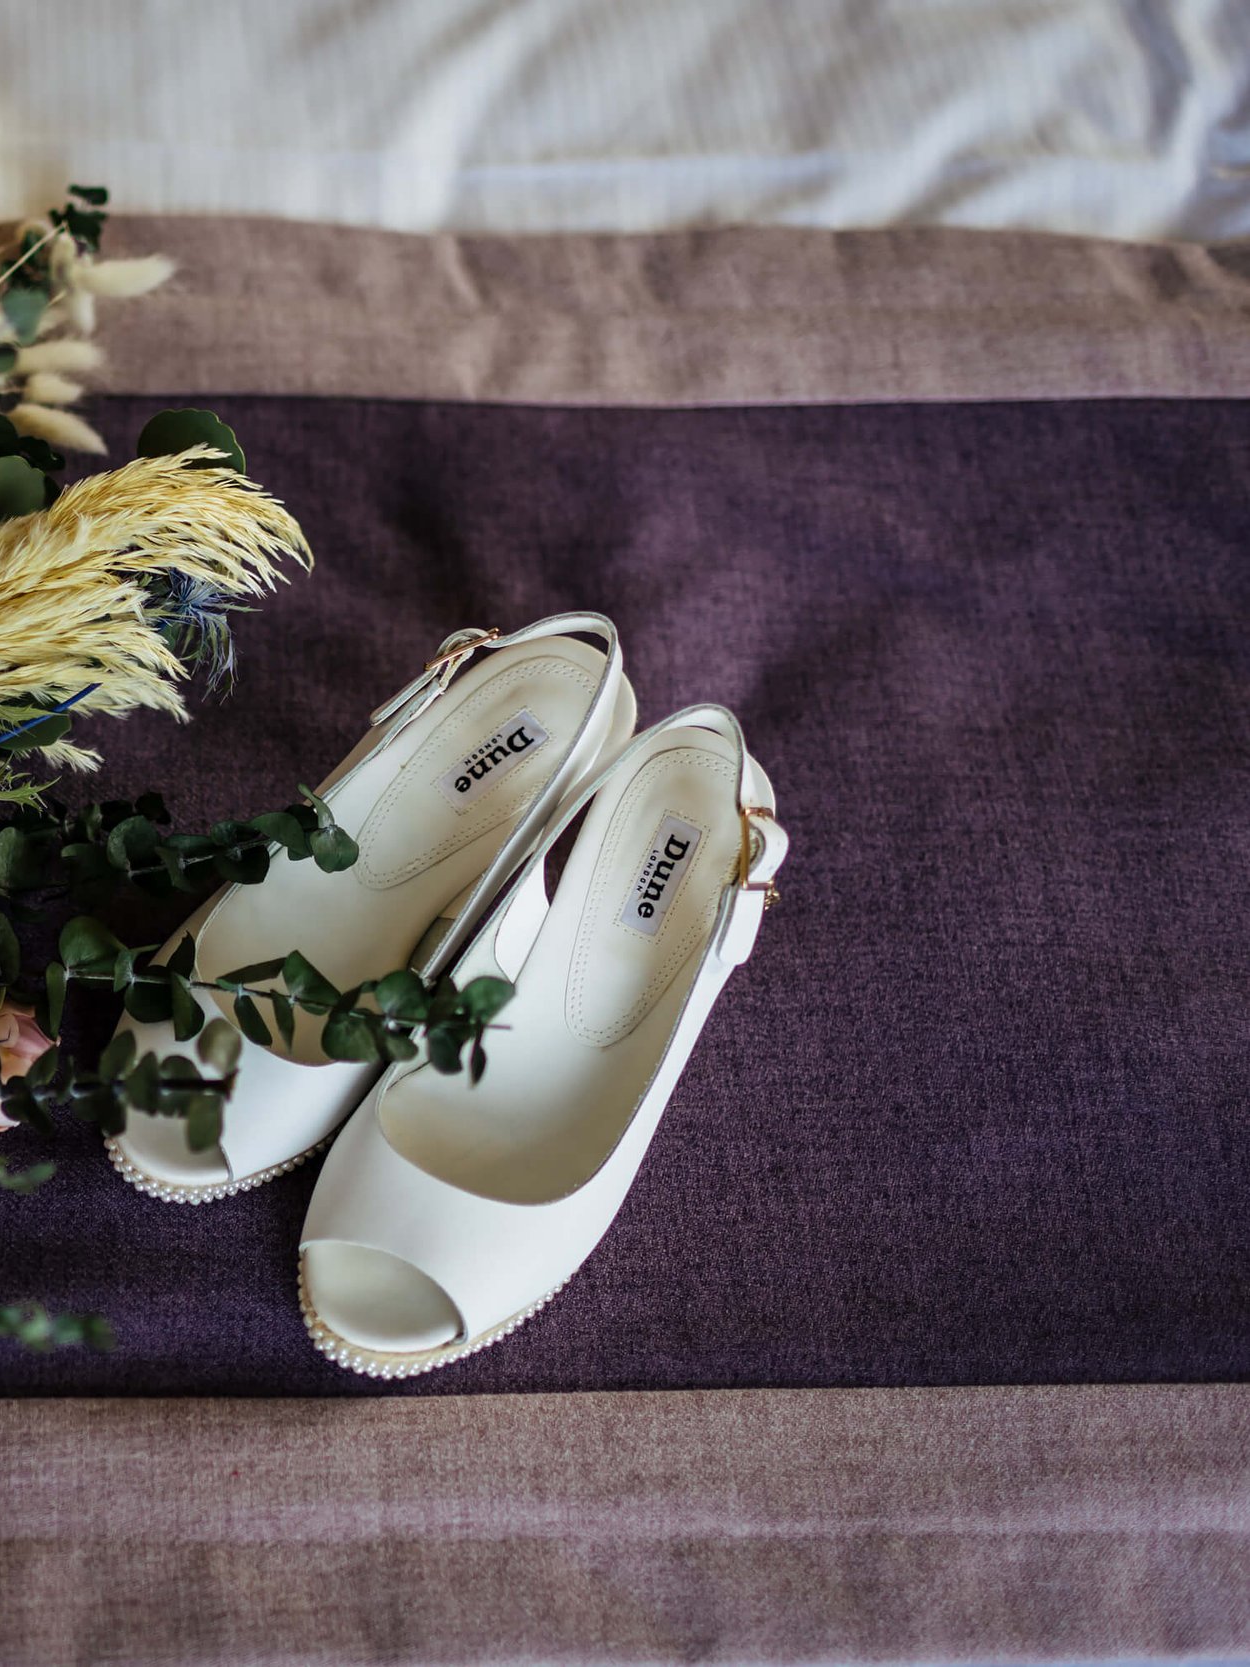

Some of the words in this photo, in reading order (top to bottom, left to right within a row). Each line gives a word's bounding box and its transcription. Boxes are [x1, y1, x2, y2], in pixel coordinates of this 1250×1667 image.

[454, 726, 535, 793] Dune
[464, 734, 503, 766] LONDON
[637, 849, 659, 892] LONDON
[637, 834, 690, 918] Dune
